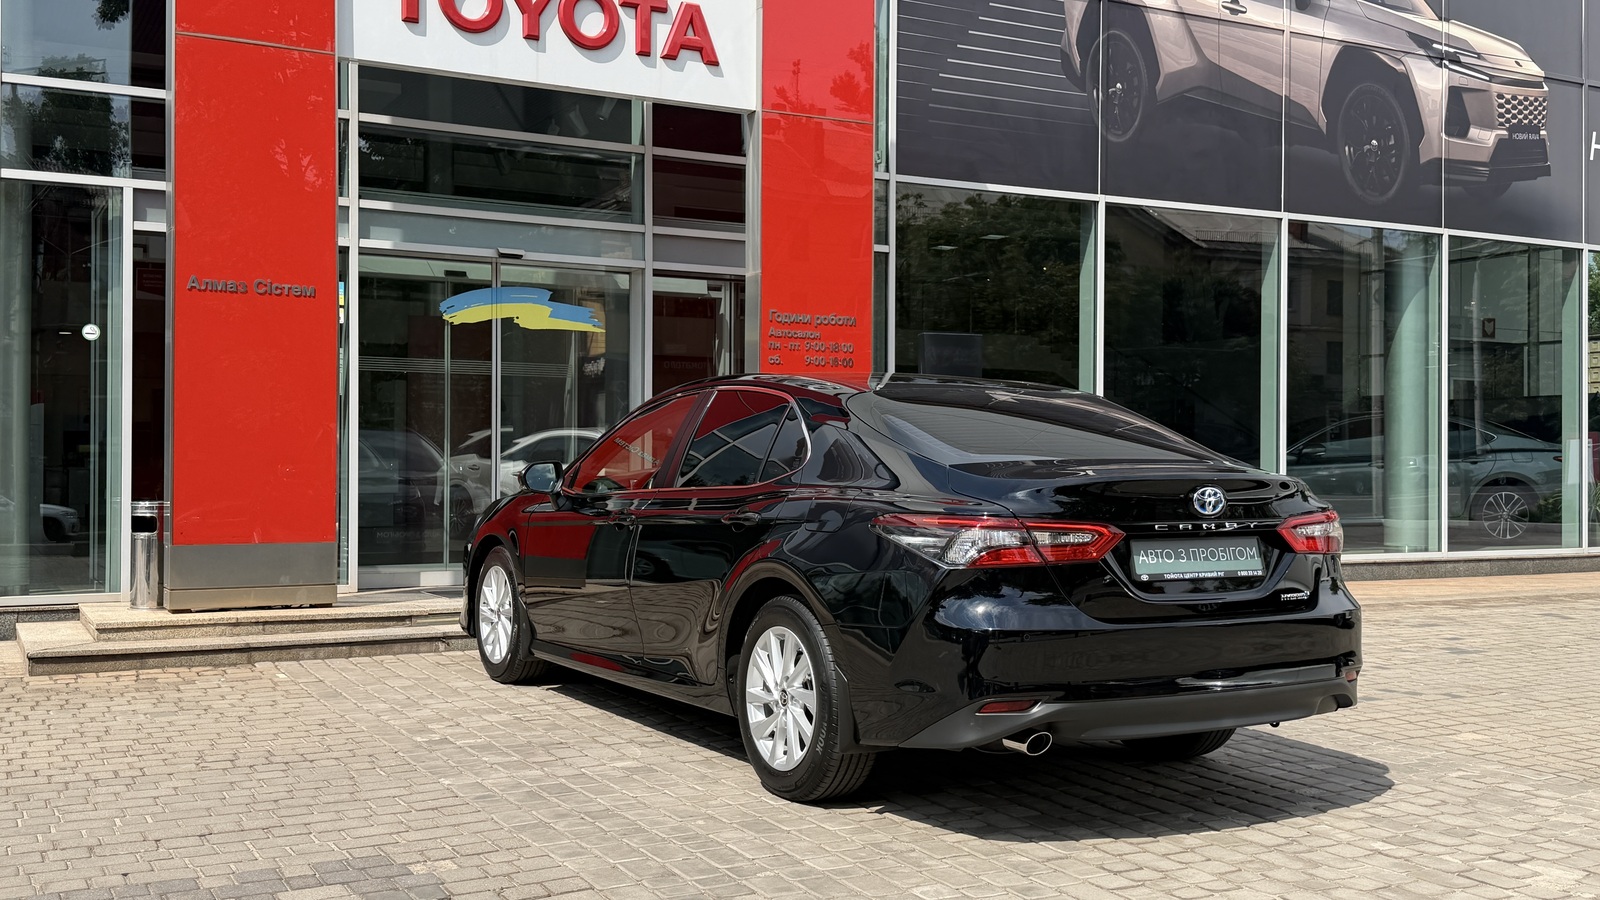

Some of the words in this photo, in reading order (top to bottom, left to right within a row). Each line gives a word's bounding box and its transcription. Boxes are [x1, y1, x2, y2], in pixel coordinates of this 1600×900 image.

[1512, 131, 1528, 140] НОВИЙ
[187, 275, 248, 293] Алмаз
[253, 278, 317, 298] Сістем
[769, 309, 812, 325] Години
[814, 312, 857, 328] роботи
[768, 327, 821, 340] Автосалон
[768, 354, 783, 365] сб.
[1154, 521, 1258, 531] CAMRY
[1139, 549, 1175, 564] АВТО
[1189, 546, 1258, 562] ПРОБІГОМ
